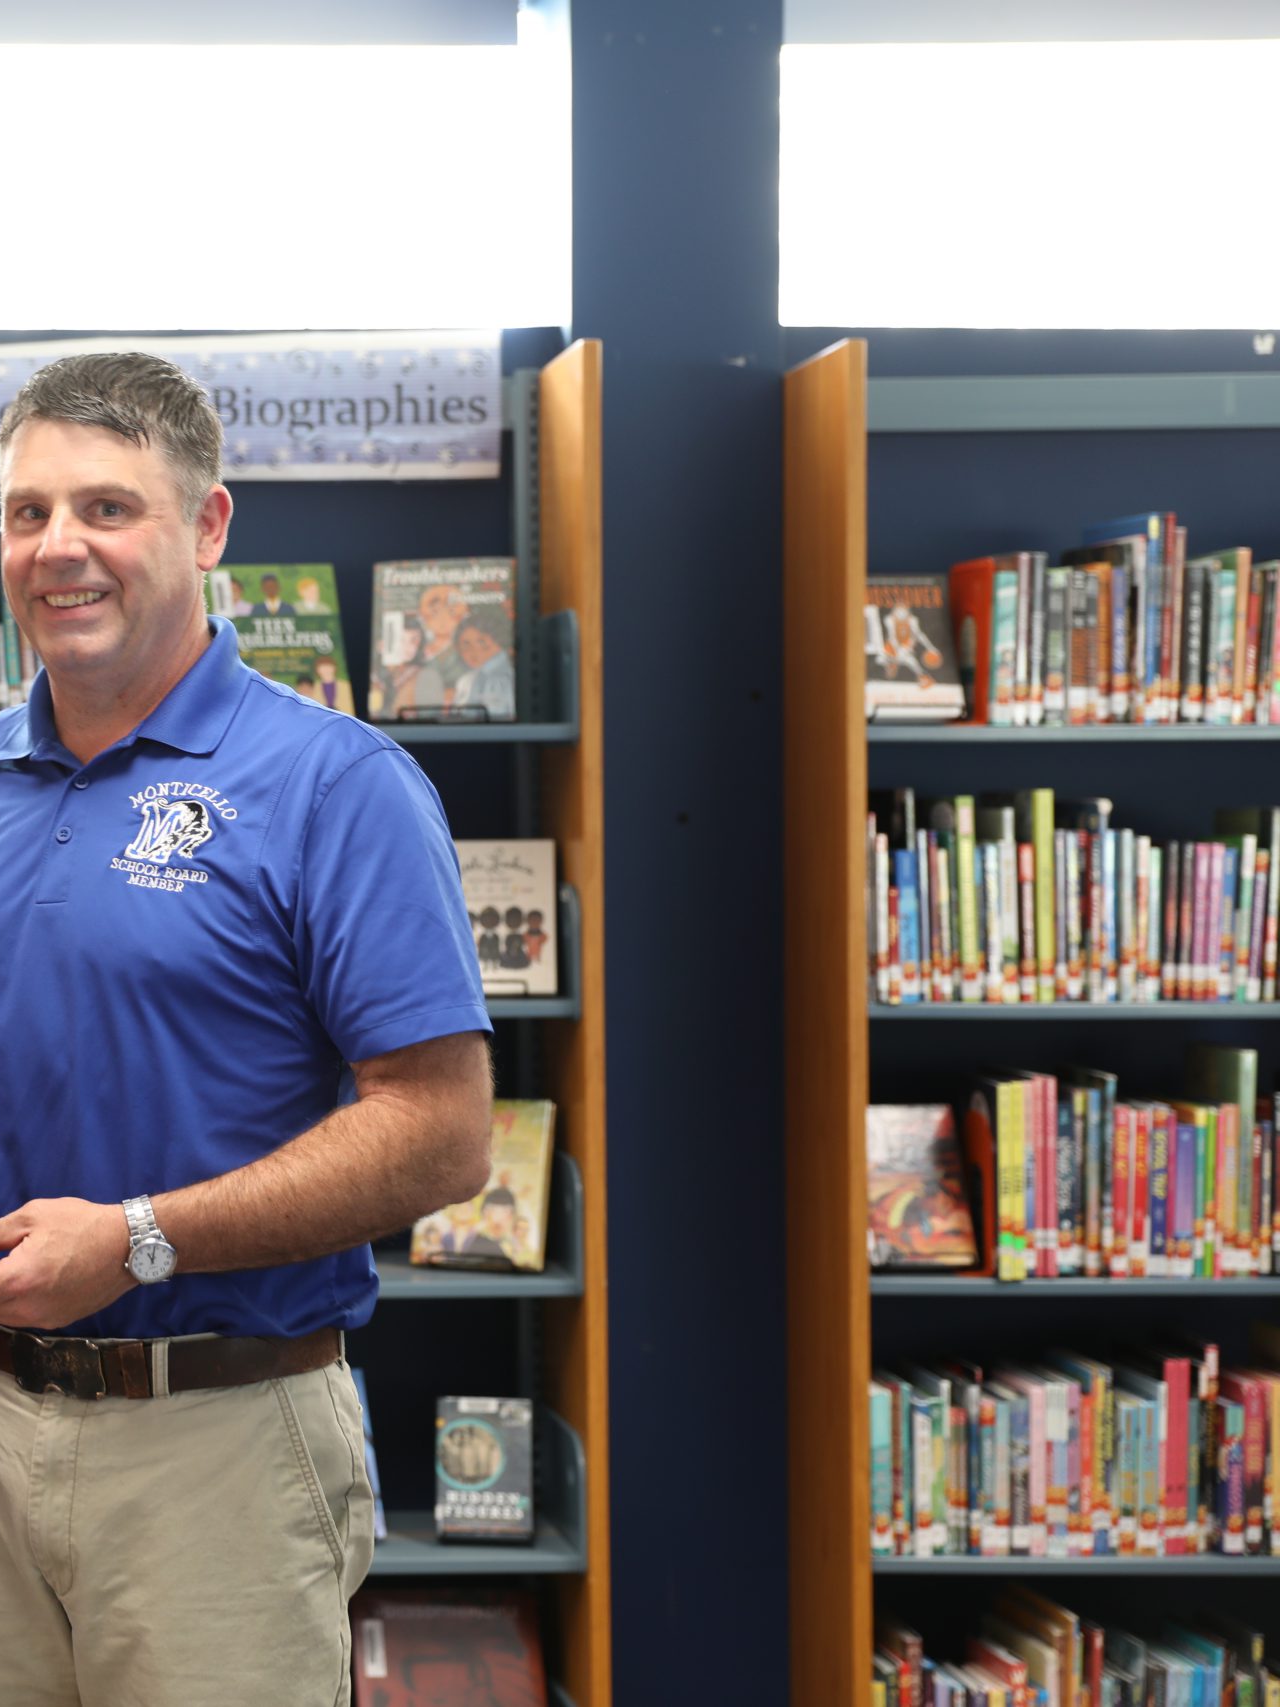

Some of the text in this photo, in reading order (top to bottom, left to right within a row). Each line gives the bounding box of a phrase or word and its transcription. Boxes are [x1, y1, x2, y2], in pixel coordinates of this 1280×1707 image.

[214, 385, 488, 435] Biographies
[129, 781, 237, 820] MONTICELLO
[110, 857, 208, 883] SCHOOL BOARD
[126, 873, 184, 893] MEMBER
